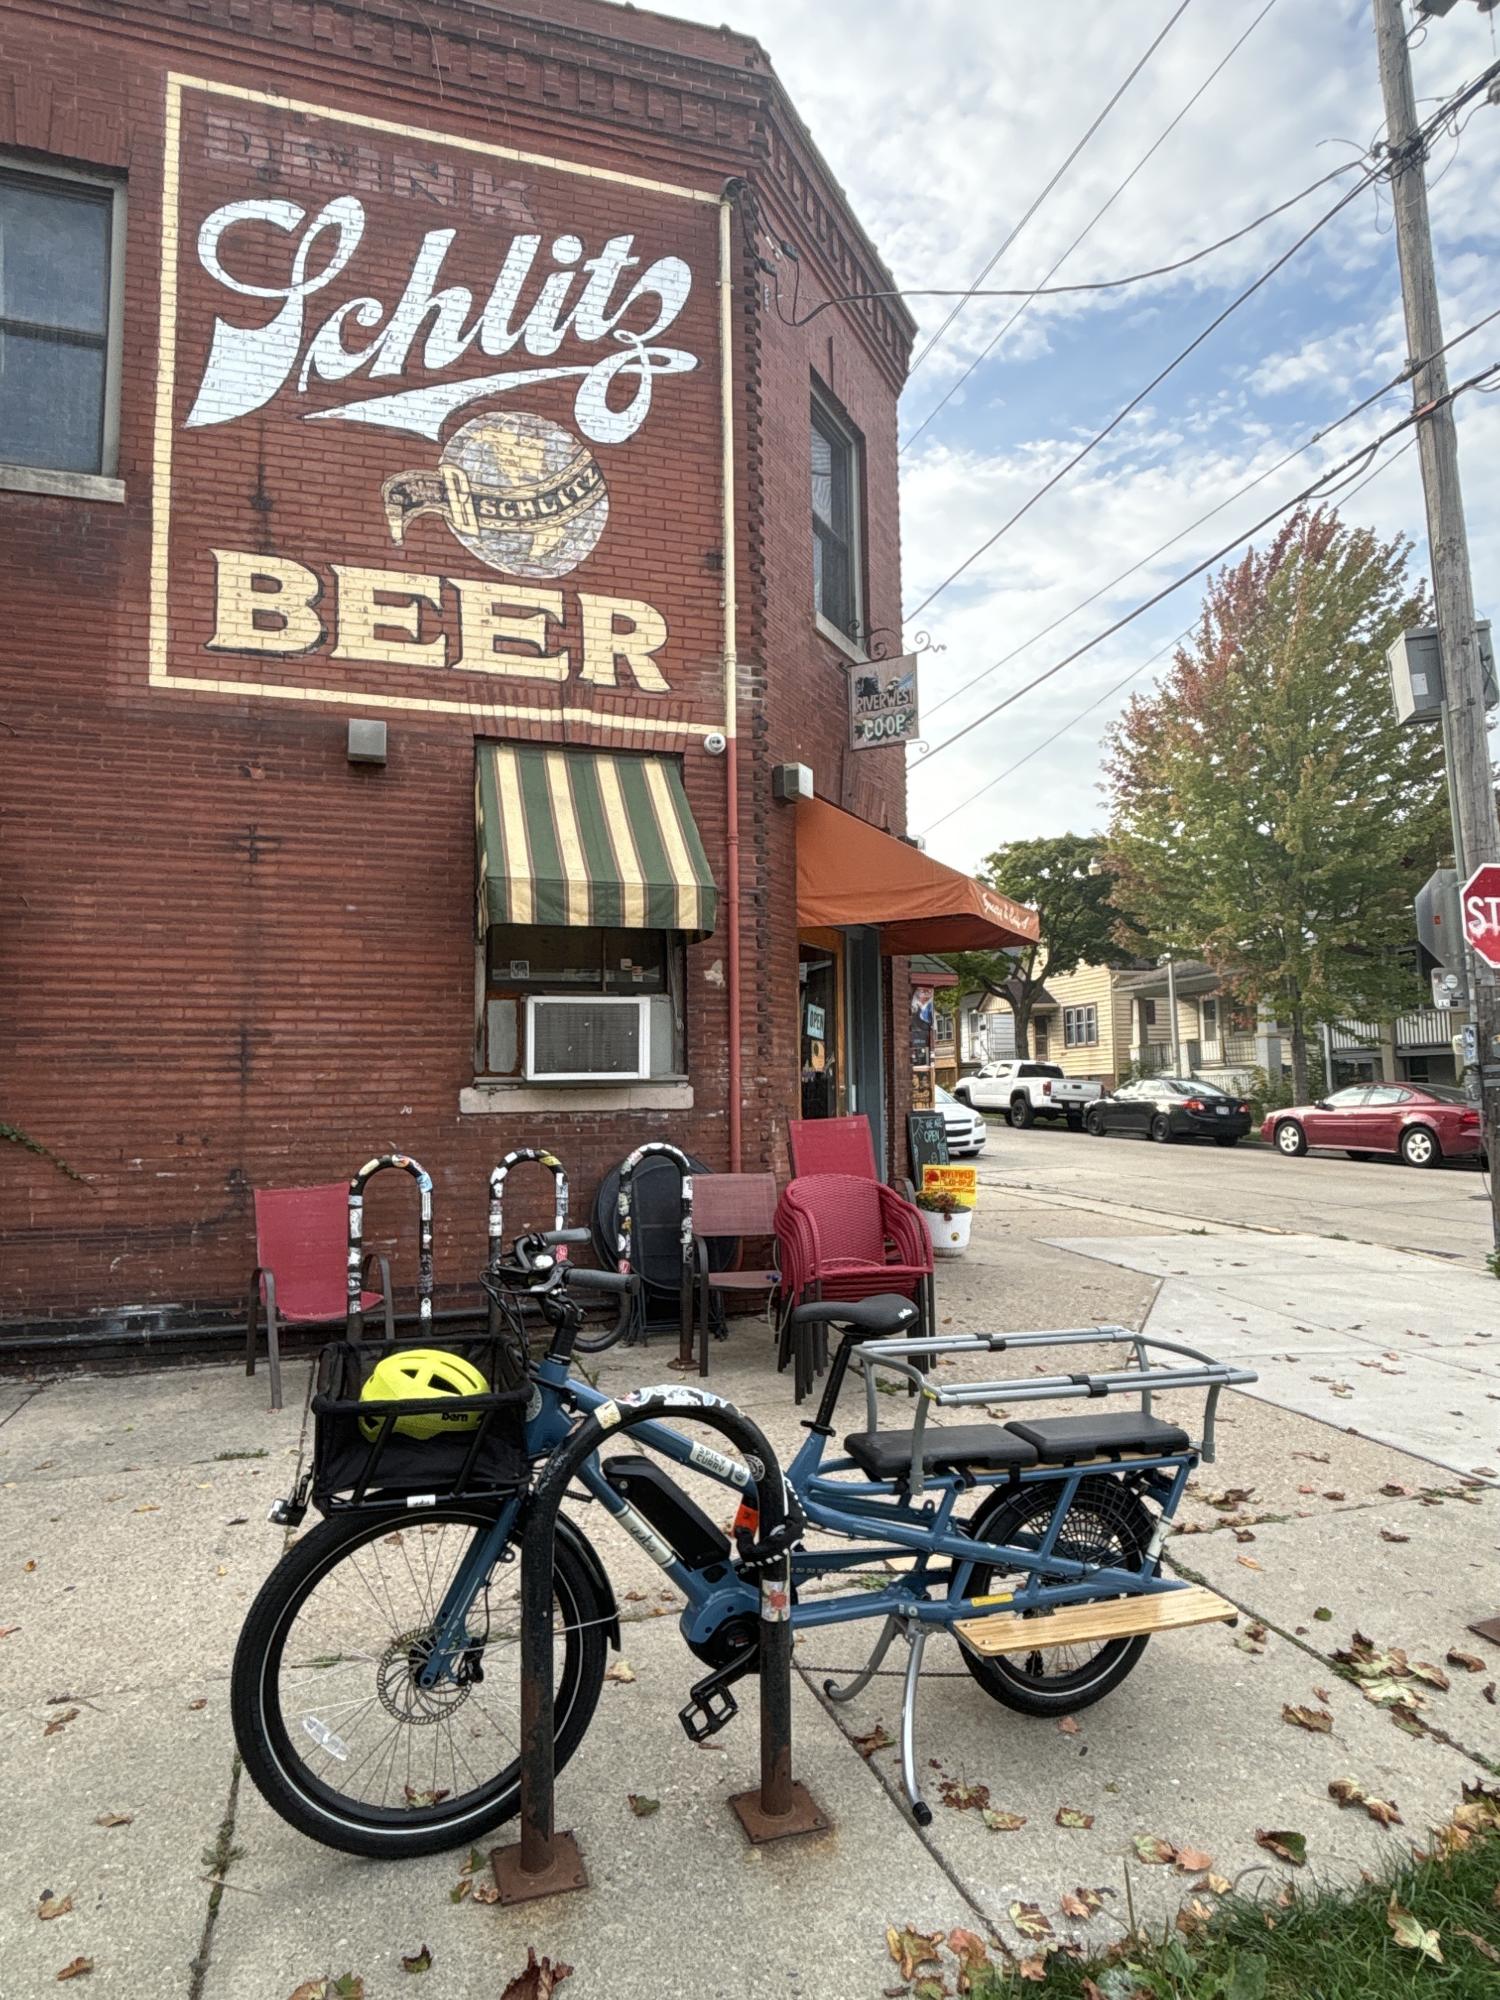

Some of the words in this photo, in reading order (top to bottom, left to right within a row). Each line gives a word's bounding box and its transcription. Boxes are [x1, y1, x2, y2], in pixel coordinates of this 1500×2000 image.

[185, 195, 699, 444] Schlitz
[479, 466, 600, 518] SCHLITZ
[207, 549, 672, 693] BEER
[857, 689, 914, 713] RIVERWEST
[1467, 896, 1500, 937] ST
[809, 1010, 824, 1032] OPEN
[924, 1130, 940, 1144] OPEN
[695, 1454, 725, 1473] CURRY
[699, 1446, 727, 1466] SPICY
